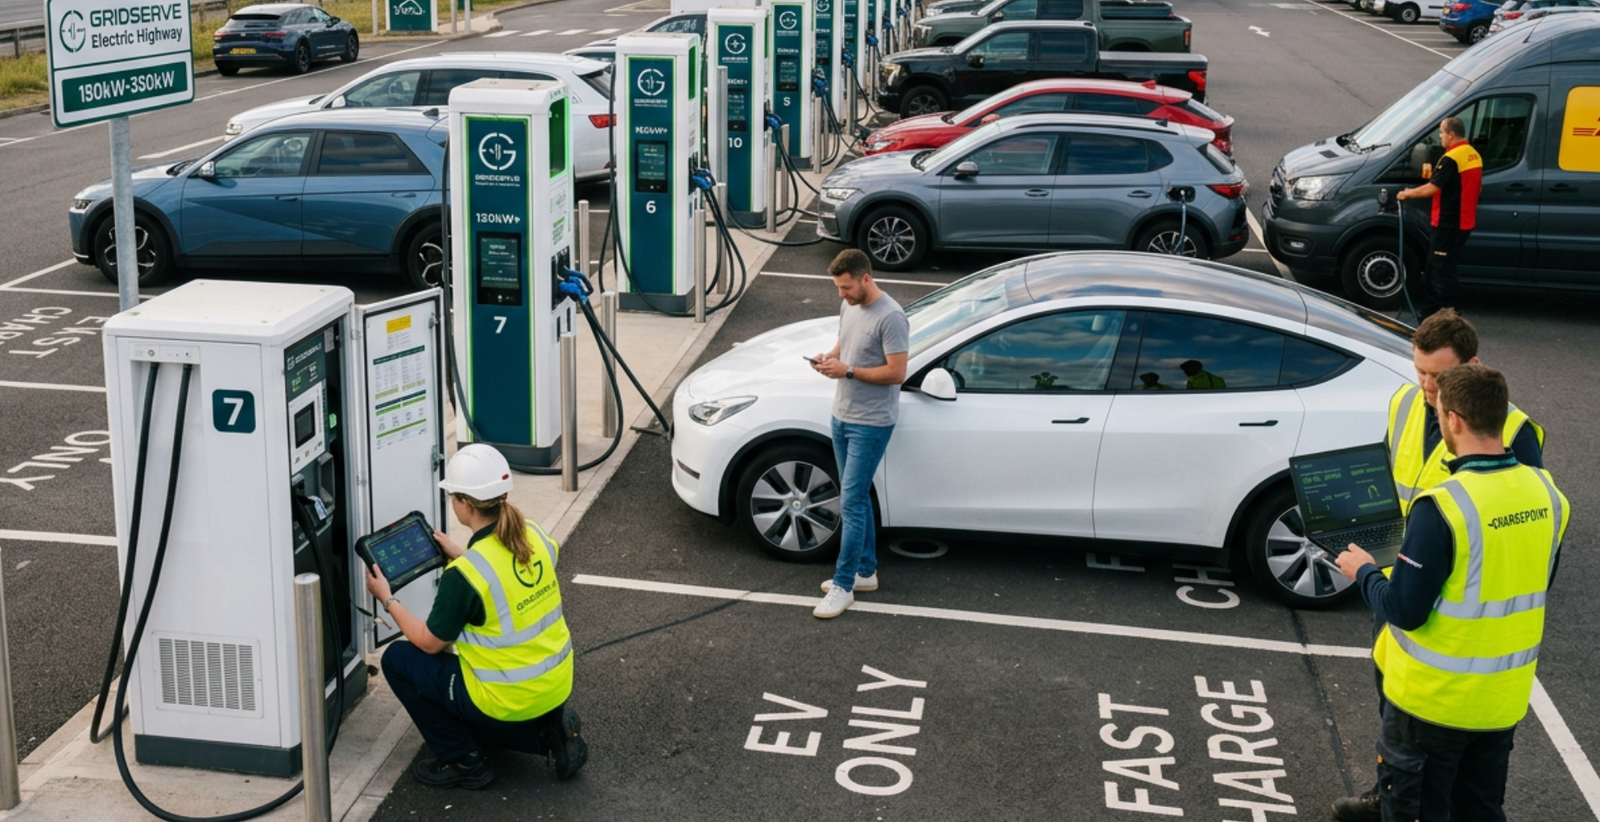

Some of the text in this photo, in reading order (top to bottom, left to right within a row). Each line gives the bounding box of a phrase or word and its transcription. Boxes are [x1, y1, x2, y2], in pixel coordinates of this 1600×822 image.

[90, 3, 182, 27] GRIDSERVE
[91, 27, 182, 48] Electric Highway
[728, 137, 743, 148] 10
[645, 200, 657, 213] 6
[493, 316, 507, 334] 7
[223, 397, 245, 426] 7
[0, 430, 111, 491] ONLY
[744, 692, 828, 757] EV
[835, 664, 927, 796] ONLY
[1098, 693, 1184, 817] FAST
[1194, 675, 1298, 822] HARGE
